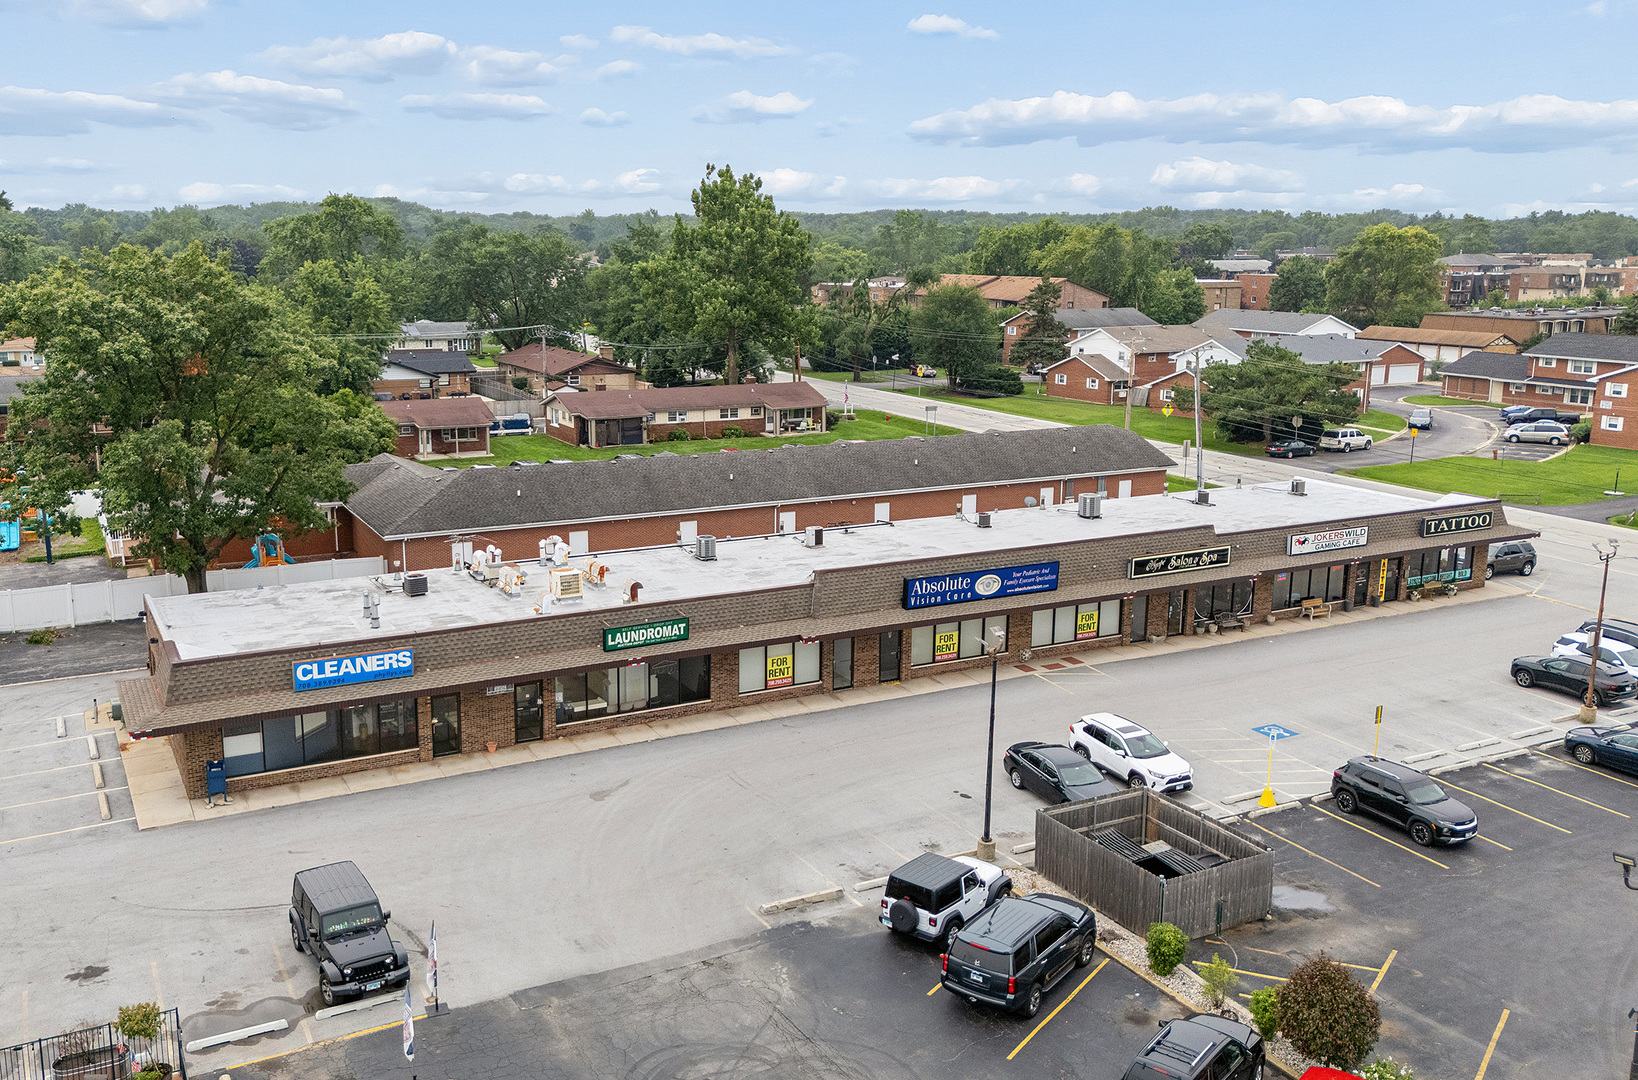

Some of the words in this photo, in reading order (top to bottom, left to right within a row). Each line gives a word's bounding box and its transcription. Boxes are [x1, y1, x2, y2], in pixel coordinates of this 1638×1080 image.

[1428, 514, 1490, 532] TATTOO
[1312, 528, 1366, 542] JOKERSWILD
[1315, 541, 1340, 550] GAMING
[1168, 554, 1192, 570] Salon
[1200, 552, 1218, 565] Spa
[912, 577, 971, 595] Absolute
[911, 596, 941, 606] Vision
[947, 592, 971, 600] Care
[1081, 614, 1094, 622] FOR
[1078, 622, 1096, 632] RENT
[608, 623, 686, 645] LAUNDROMAT
[940, 634, 953, 643] FOR
[937, 643, 956, 653] RENT
[296, 651, 412, 681] CLEANERS
[772, 657, 787, 667] FOR
[374, 668, 412, 679] phyllys.com
[769, 667, 790, 678] RENT
[298, 678, 345, 689] 708.389.9394
